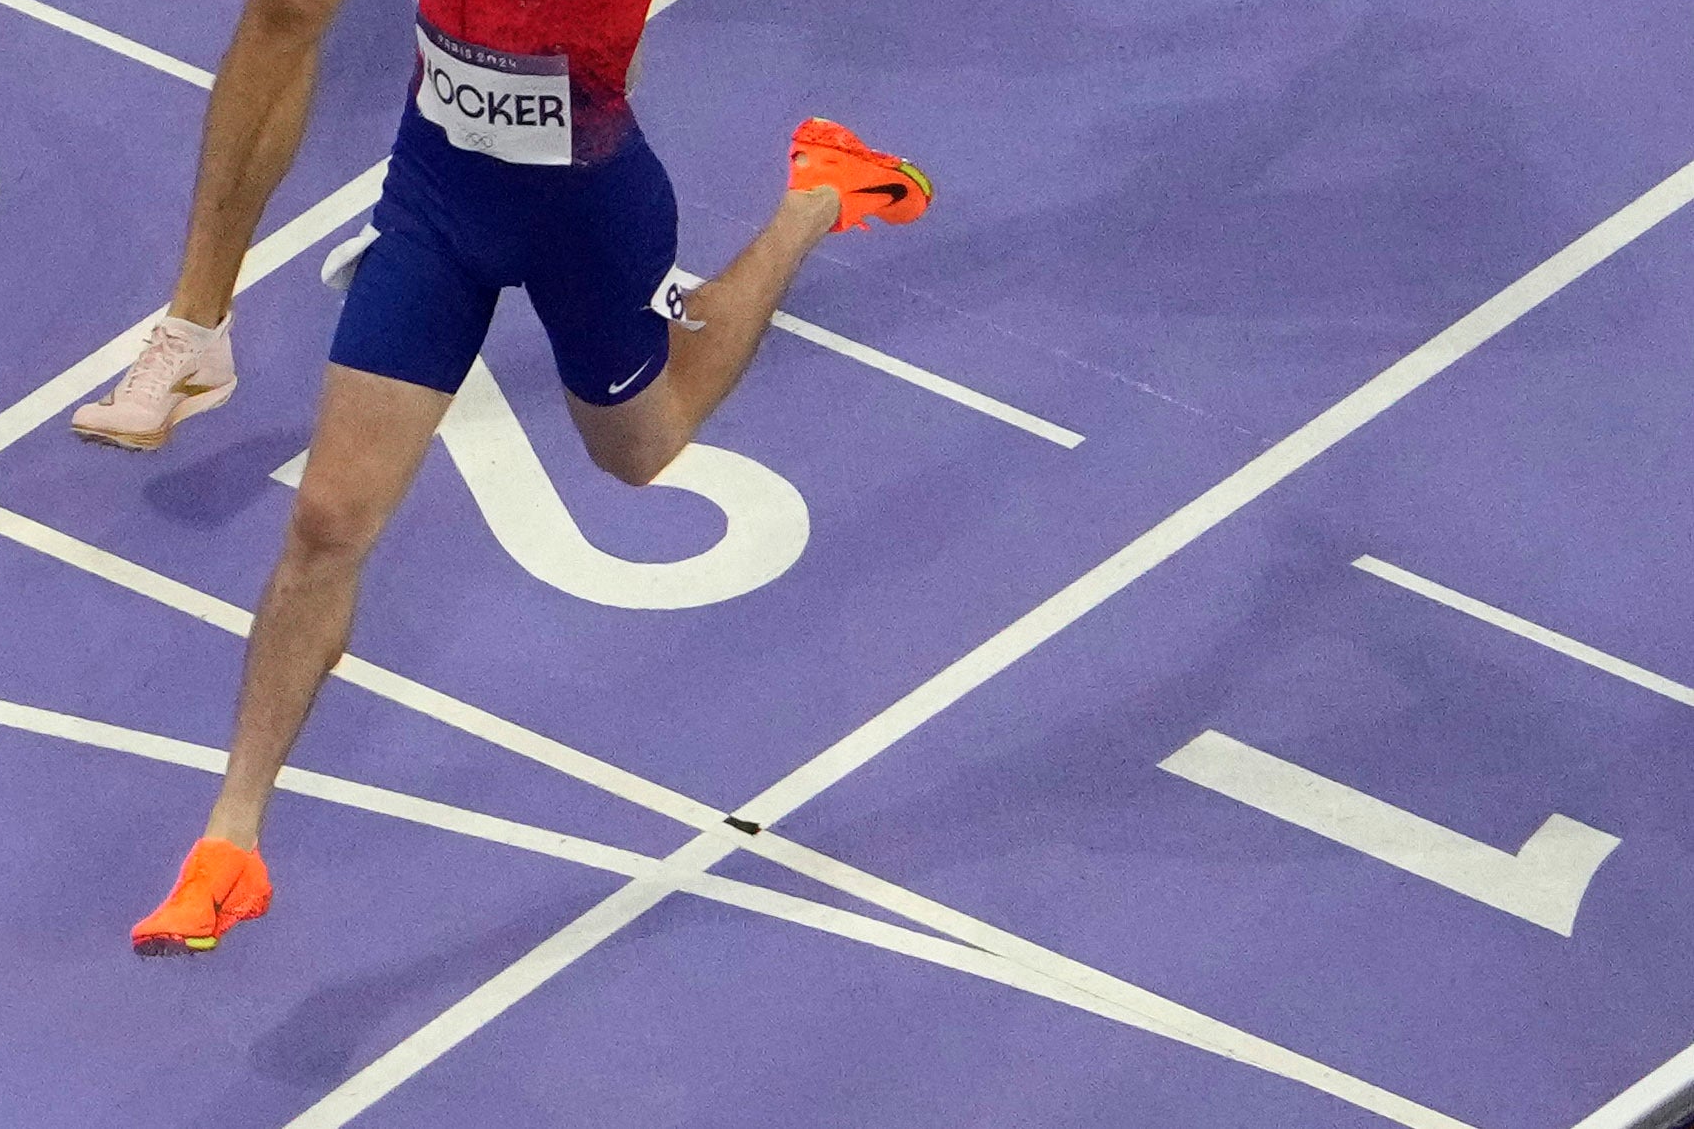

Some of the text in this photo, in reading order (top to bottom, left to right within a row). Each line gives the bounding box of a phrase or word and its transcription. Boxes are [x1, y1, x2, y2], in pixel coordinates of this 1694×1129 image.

[437, 34, 517, 68] PARIS 2024
[666, 282, 684, 320] 8
[269, 354, 810, 611] 2
[1156, 729, 1622, 937] 1
